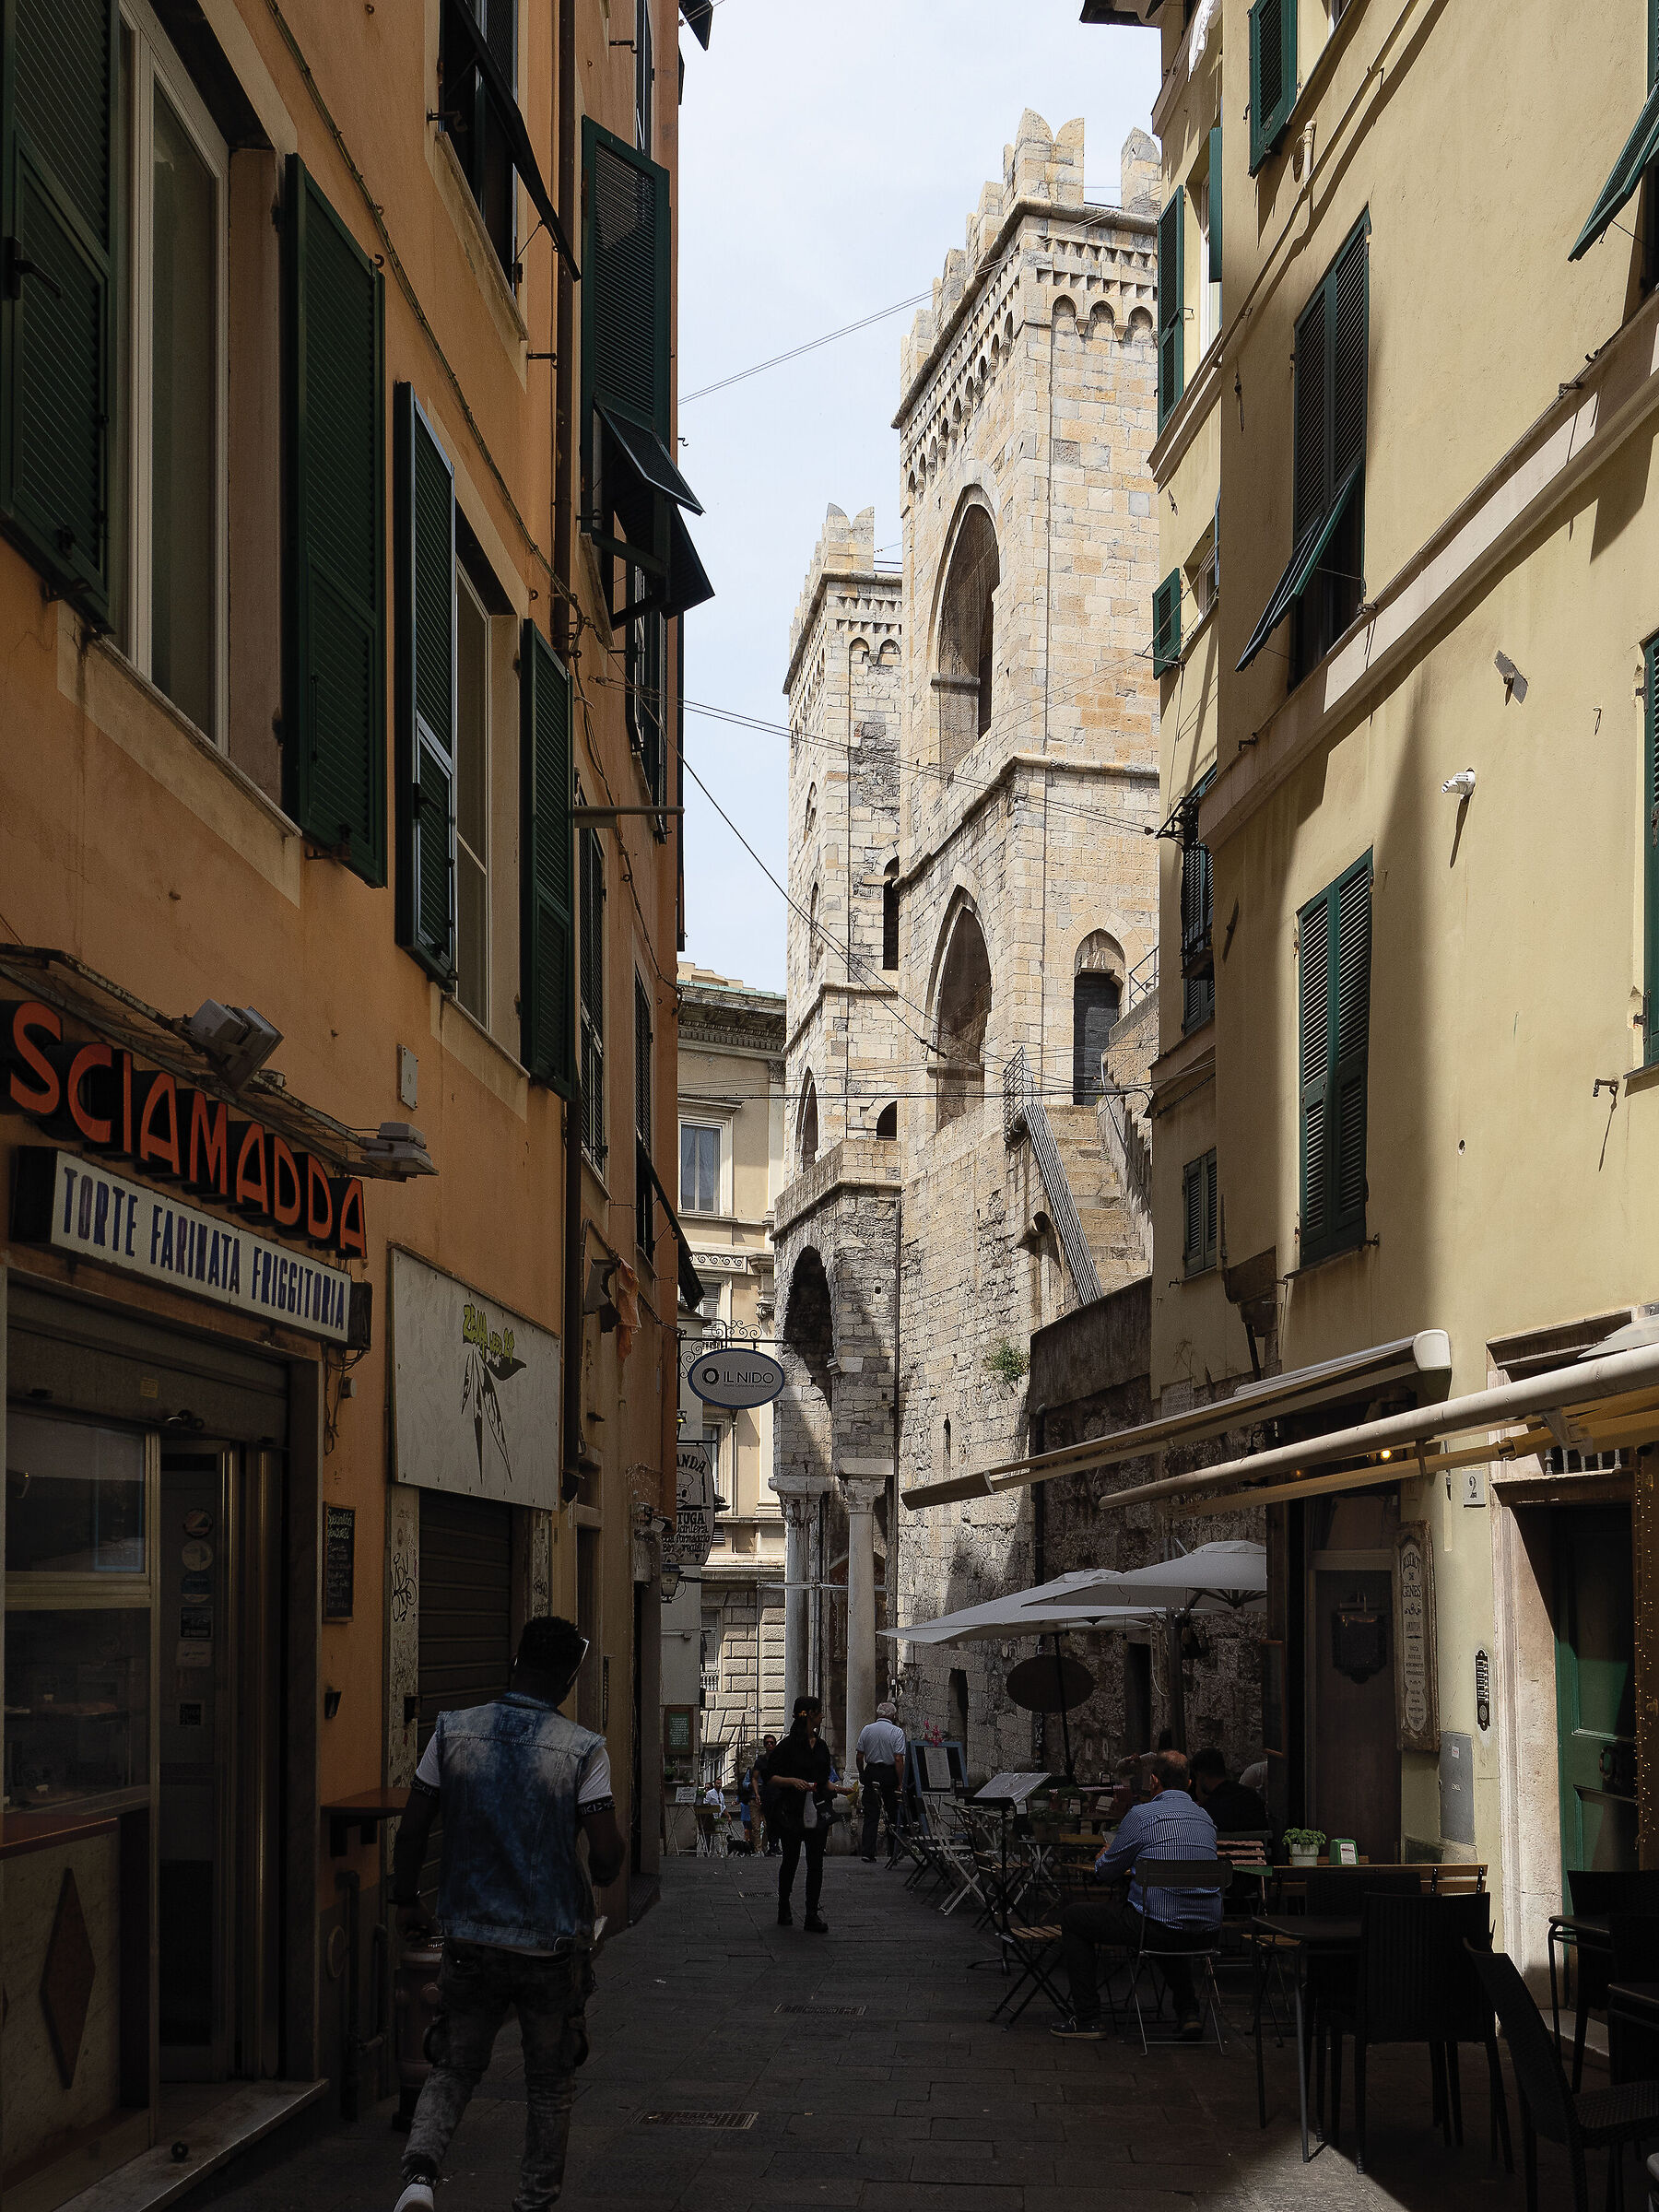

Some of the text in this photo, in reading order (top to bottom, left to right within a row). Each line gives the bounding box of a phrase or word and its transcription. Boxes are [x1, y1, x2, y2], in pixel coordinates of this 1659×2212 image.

[10, 1001, 367, 1258] SCIAMADDA
[64, 1167, 345, 1330] TORTE FARINATA FRIGGITORIA
[724, 1371, 774, 1383] IL NIDO
[1469, 1476, 1477, 1498] 2
